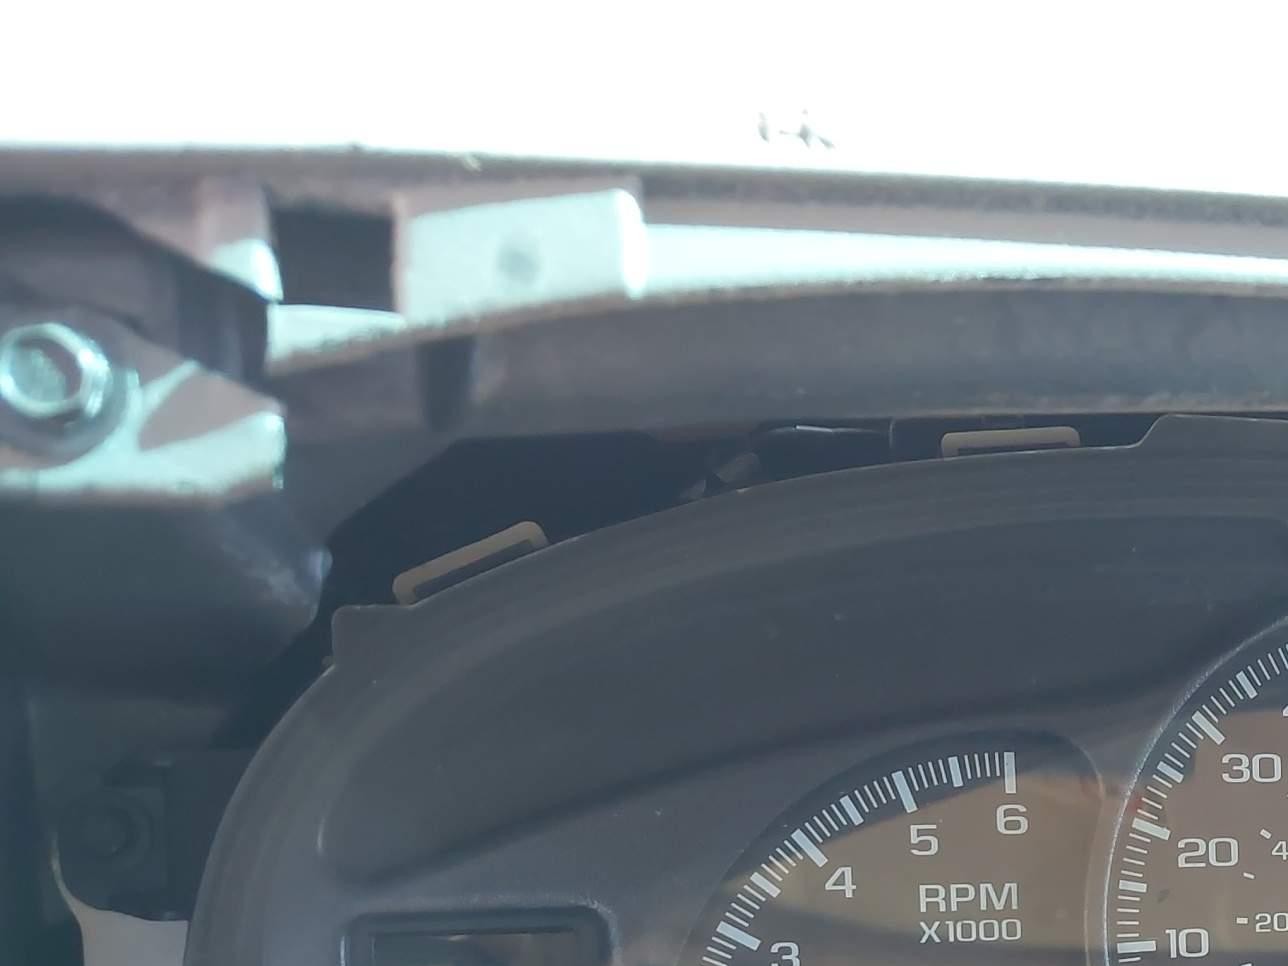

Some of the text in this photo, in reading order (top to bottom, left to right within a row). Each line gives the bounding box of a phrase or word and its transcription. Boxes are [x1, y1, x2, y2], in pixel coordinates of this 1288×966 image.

[1221, 753, 1281, 783] 30
[996, 804, 1029, 835] 6
[910, 824, 939, 855] 5
[1177, 837, 1239, 868] 20
[825, 867, 856, 898] 4
[919, 883, 1019, 912] RPM
[919, 919, 1022, 943] X1000
[1165, 928, 1209, 958] 10
